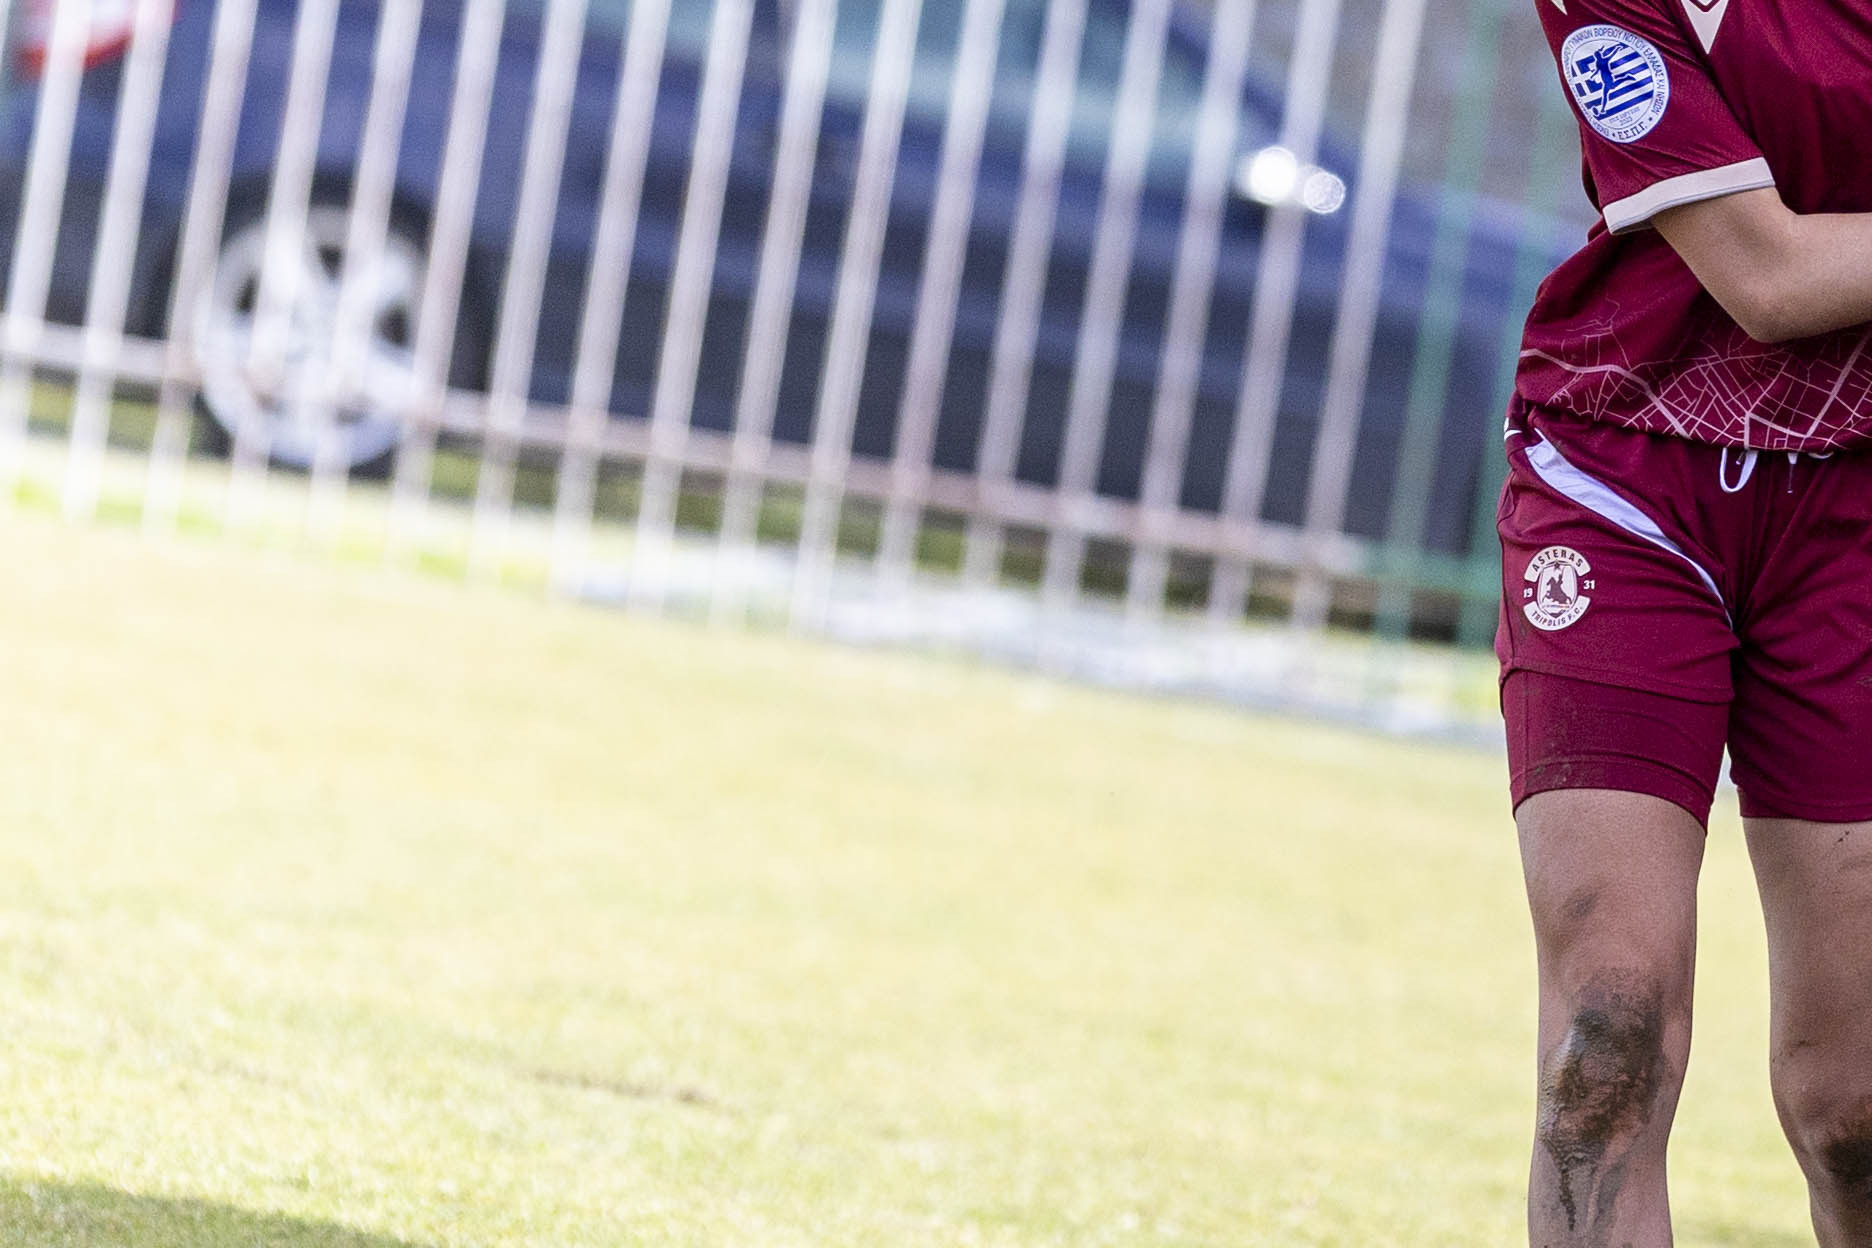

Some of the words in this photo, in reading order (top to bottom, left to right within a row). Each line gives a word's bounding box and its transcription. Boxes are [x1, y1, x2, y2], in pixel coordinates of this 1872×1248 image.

[1532, 549, 1583, 572] ASTERAS
[1523, 588, 1533, 598] 19
[1583, 580, 1595, 590] 31
[1532, 610, 1566, 627] TRIPOLIS
